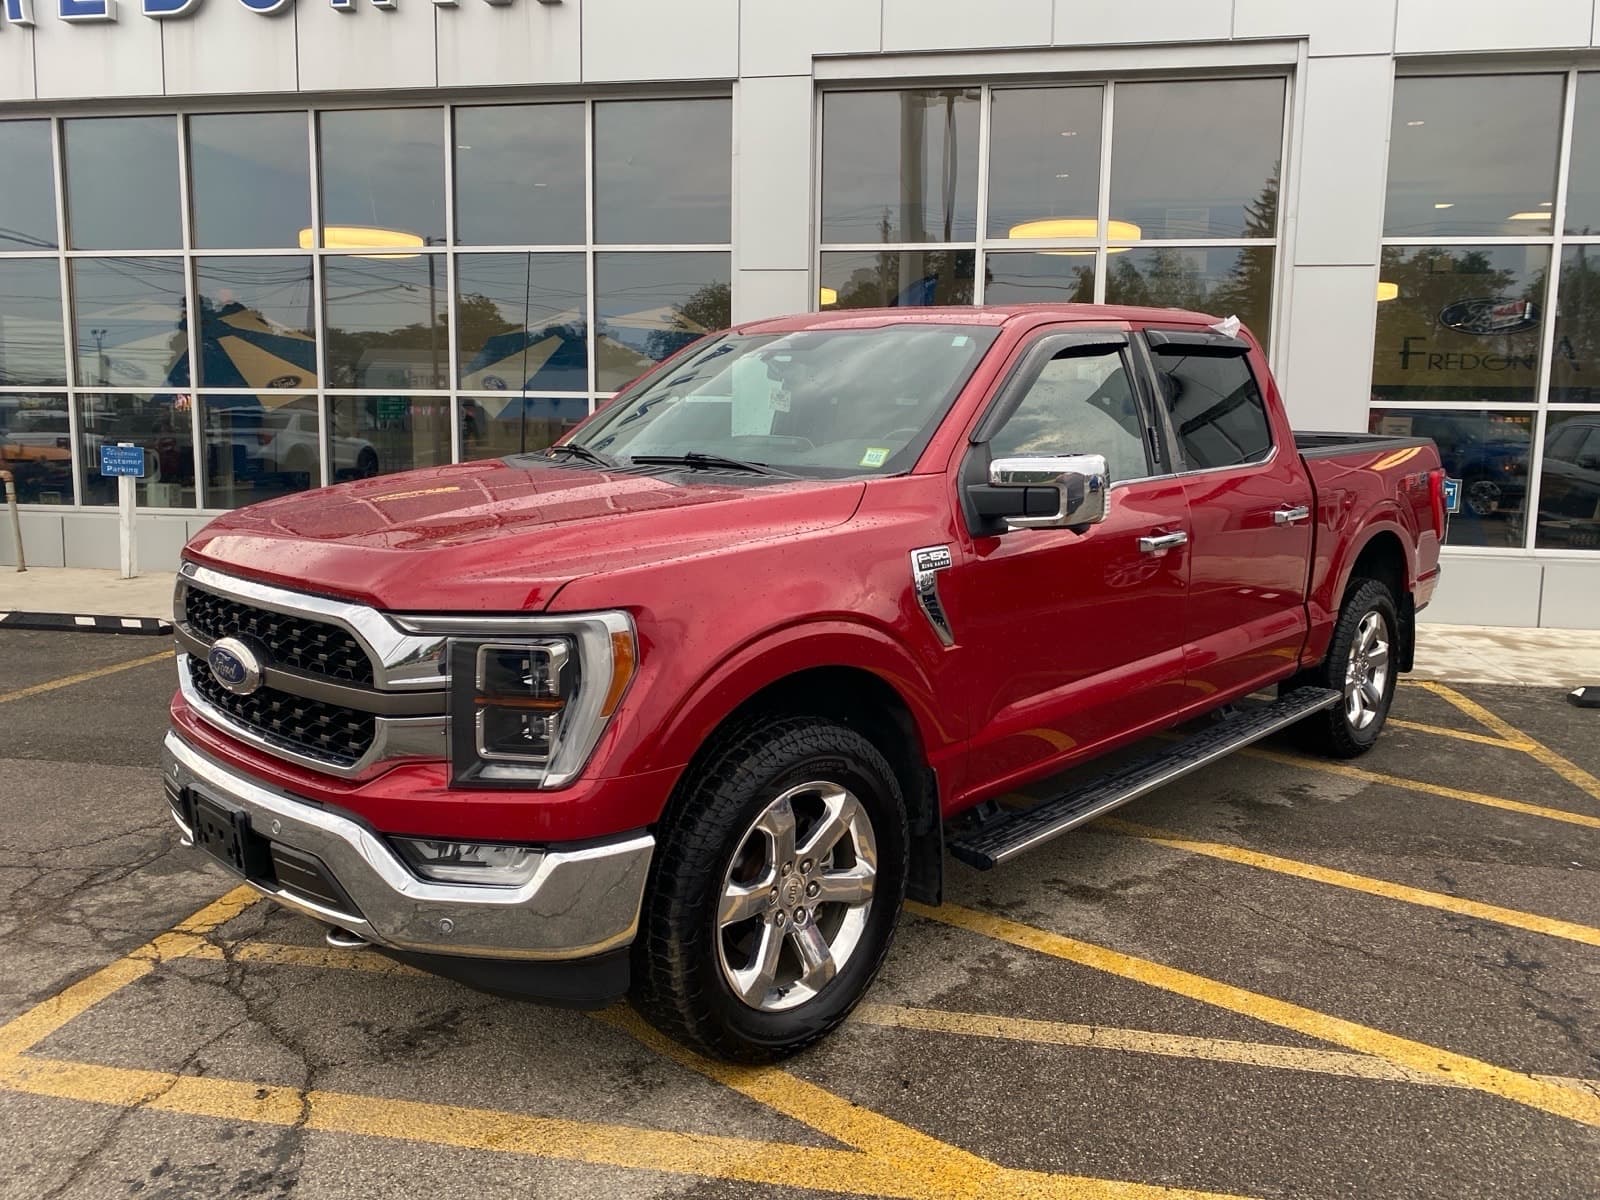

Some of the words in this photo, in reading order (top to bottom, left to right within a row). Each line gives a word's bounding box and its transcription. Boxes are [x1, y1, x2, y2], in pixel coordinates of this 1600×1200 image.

[1399, 335, 1581, 373] FREDONA
[103, 457, 142, 465] Customer
[106, 465, 139, 474] Parking
[918, 550, 950, 563] F-150
[214, 652, 238, 680] Ford
